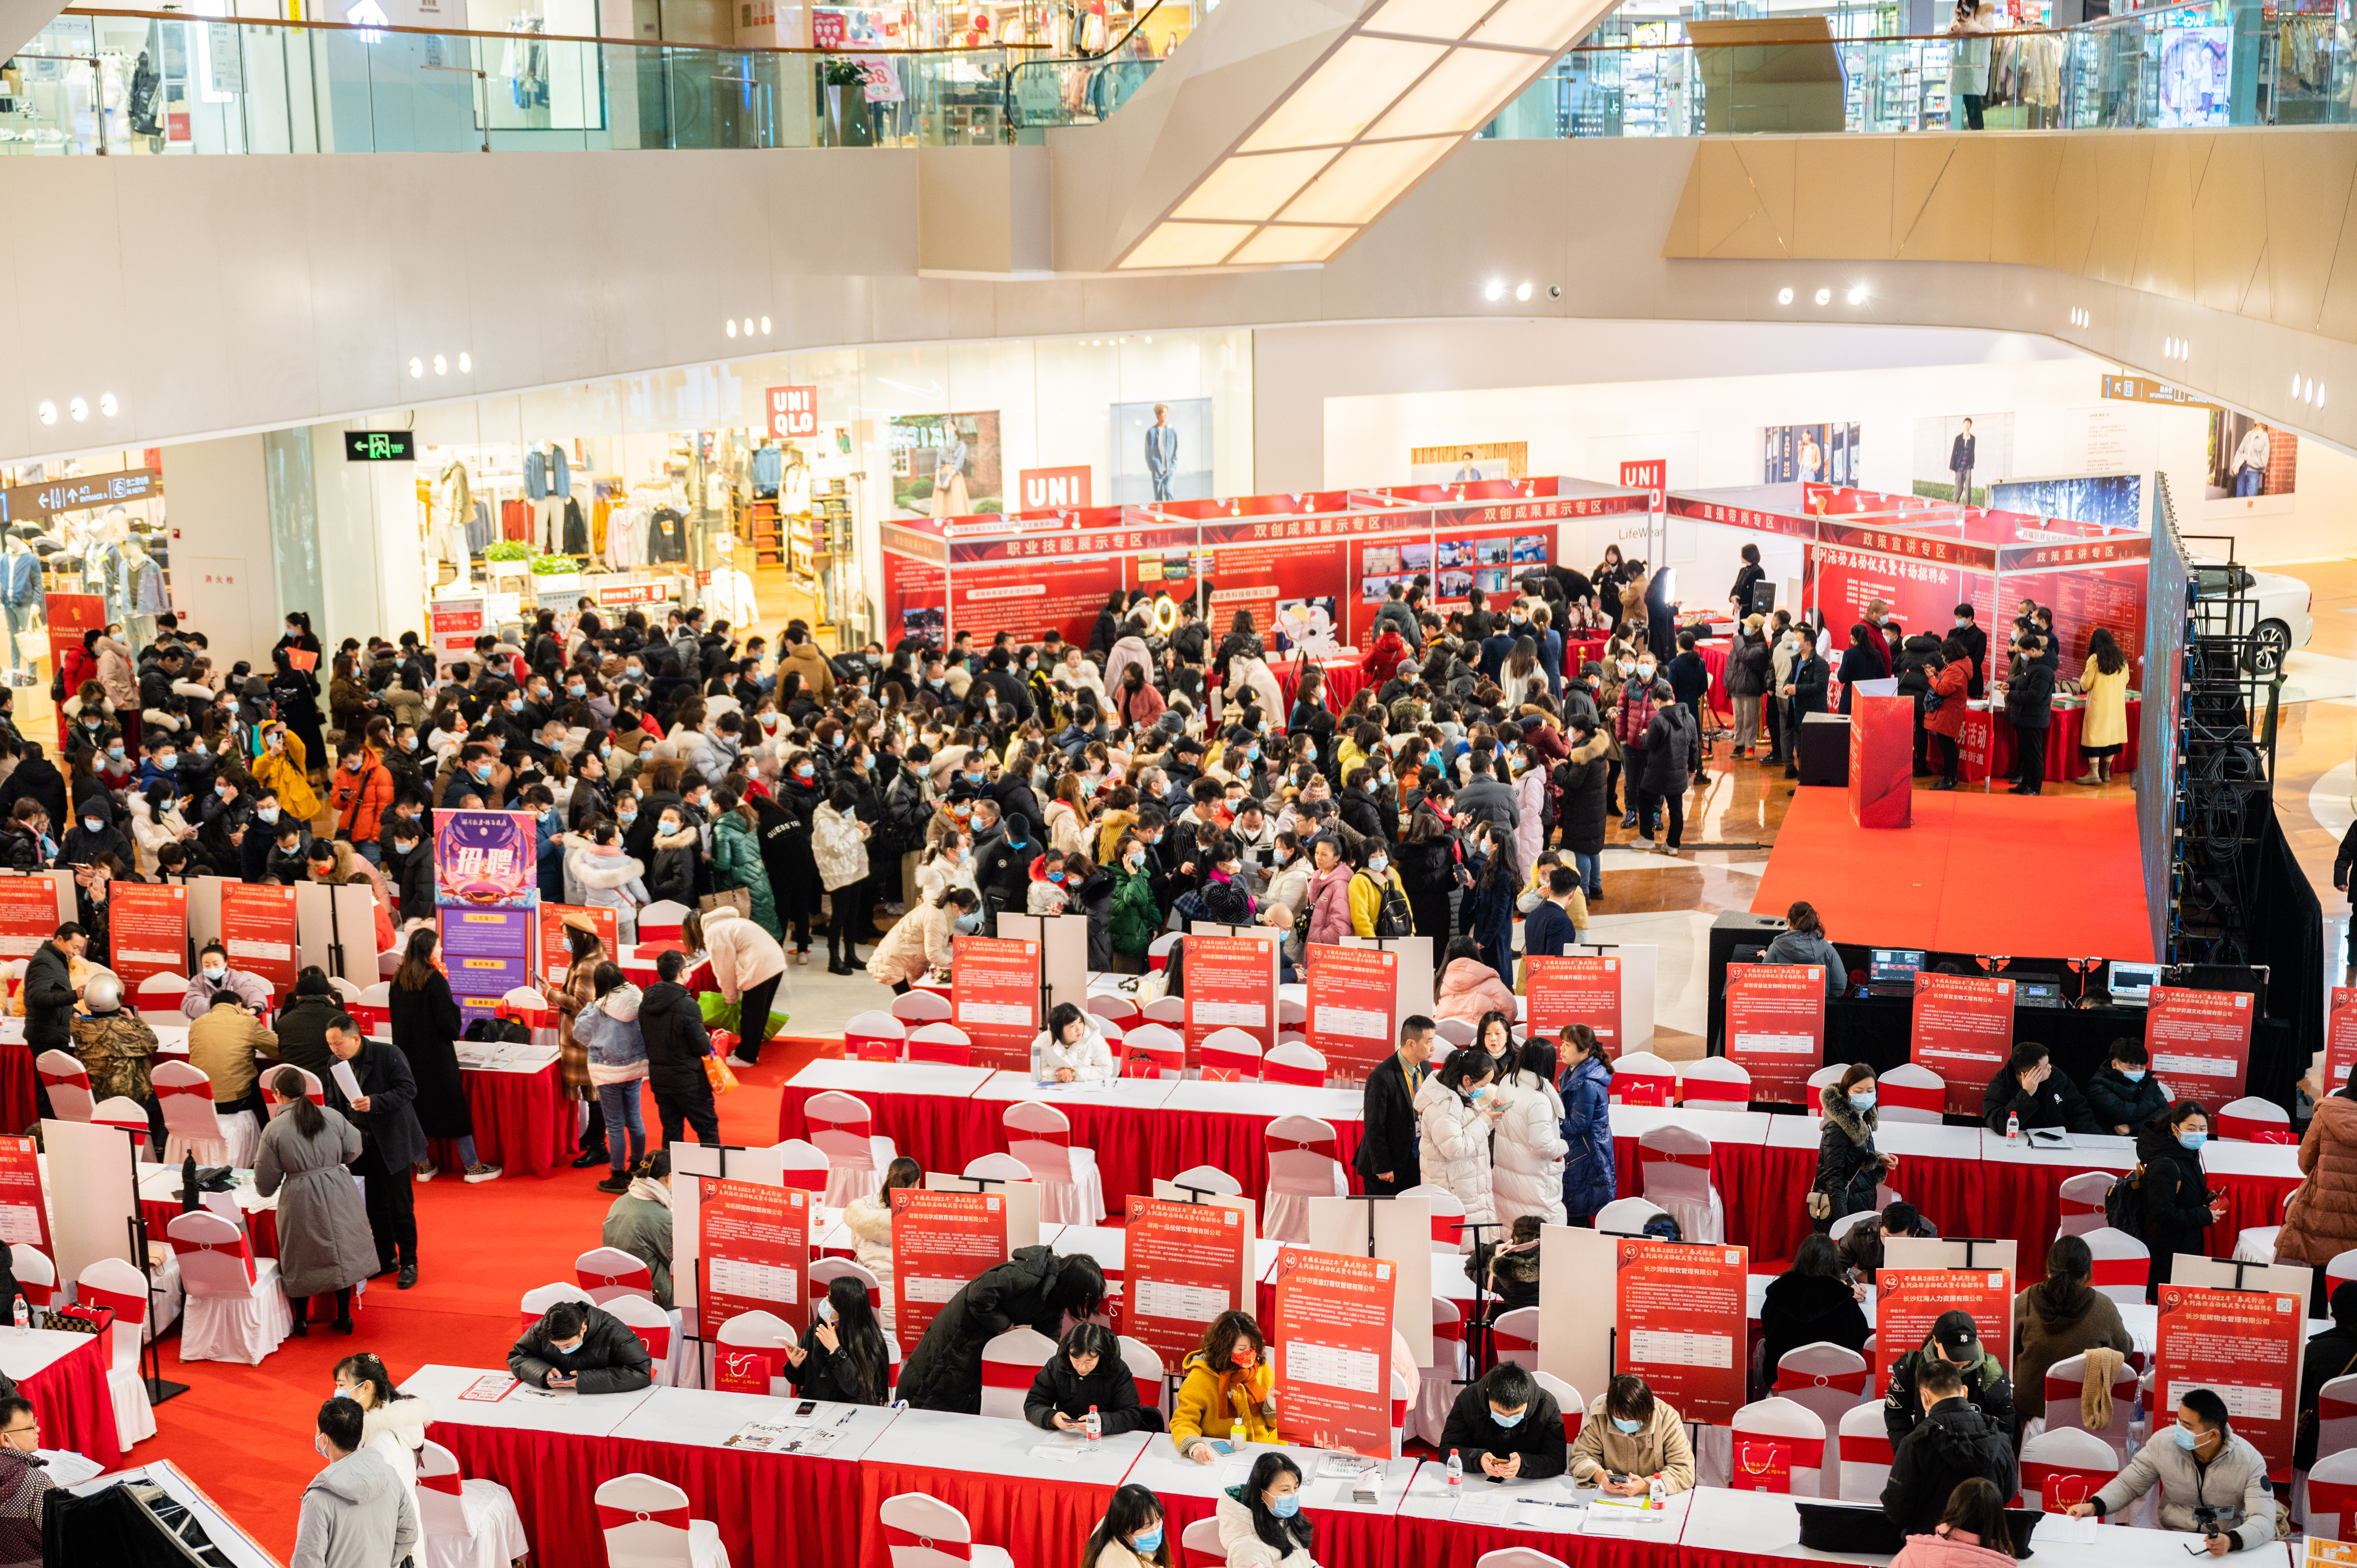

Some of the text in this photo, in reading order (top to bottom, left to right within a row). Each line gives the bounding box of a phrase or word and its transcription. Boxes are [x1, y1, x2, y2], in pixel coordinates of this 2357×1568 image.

[774, 391, 809, 411] UNI
[775, 413, 813, 435] QLO
[1625, 466, 1657, 486] UNI
[80, 493, 103, 503] ENTRANCE
[1028, 476, 1079, 507] UNI
[1484, 499, 1602, 521] 双创成果展示专区
[1704, 504, 1774, 529] 直播带岗专区
[1254, 516, 1380, 538] 双创成果展示专区
[1007, 533, 1143, 556] 职业技能展示专区
[1863, 533, 1946, 559] 政策宣讲专区
[2037, 546, 2114, 563] 政策宣讲专区
[205, 575, 233, 584] 消火栓
[1209, 588, 1272, 600] 南途秀科技有限公司
[456, 847, 514, 876] 招聘
[724, 1202, 783, 1216] 海底捞国际控股有限公司
[908, 1213, 988, 1223] 湖南华远学成教育培训发展有限公司
[1147, 1222, 1221, 1236] 湖南一品佳餐饮管理有限公司
[1644, 1266, 1719, 1277] 长沙润民餐饮管理有限公司
[1295, 1276, 1375, 1293] 长沙市壹盏灯餐饮管理有限公司
[2168, 1294, 2179, 1302] 43
[2186, 1313, 2270, 1325] 长沙旭辉物业管理有限公司
